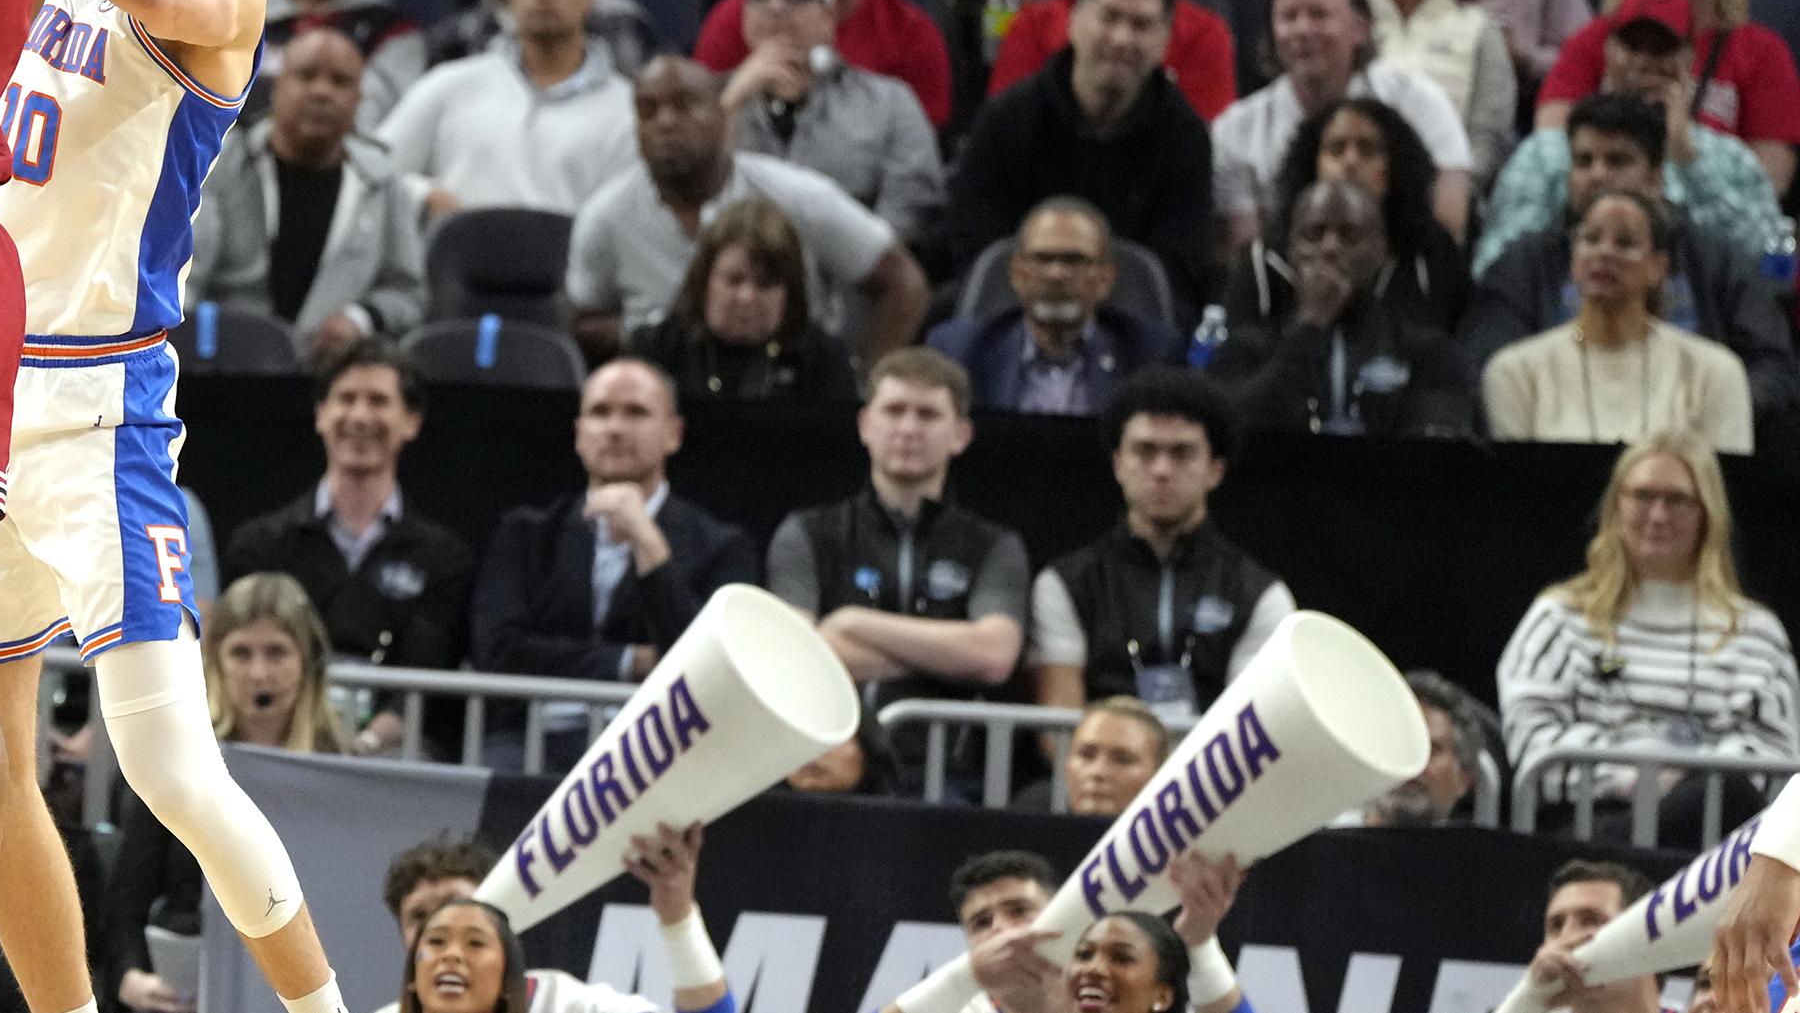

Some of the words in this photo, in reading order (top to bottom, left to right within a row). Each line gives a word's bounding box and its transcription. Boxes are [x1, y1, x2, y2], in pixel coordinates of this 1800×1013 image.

[23, 4, 110, 86] ORIDA
[1, 81, 63, 188] 10
[144, 524, 187, 603] F
[515, 674, 711, 899] FLORIDA
[1081, 701, 1281, 910] FLORIDA
[1646, 819, 1762, 944] FLOR
